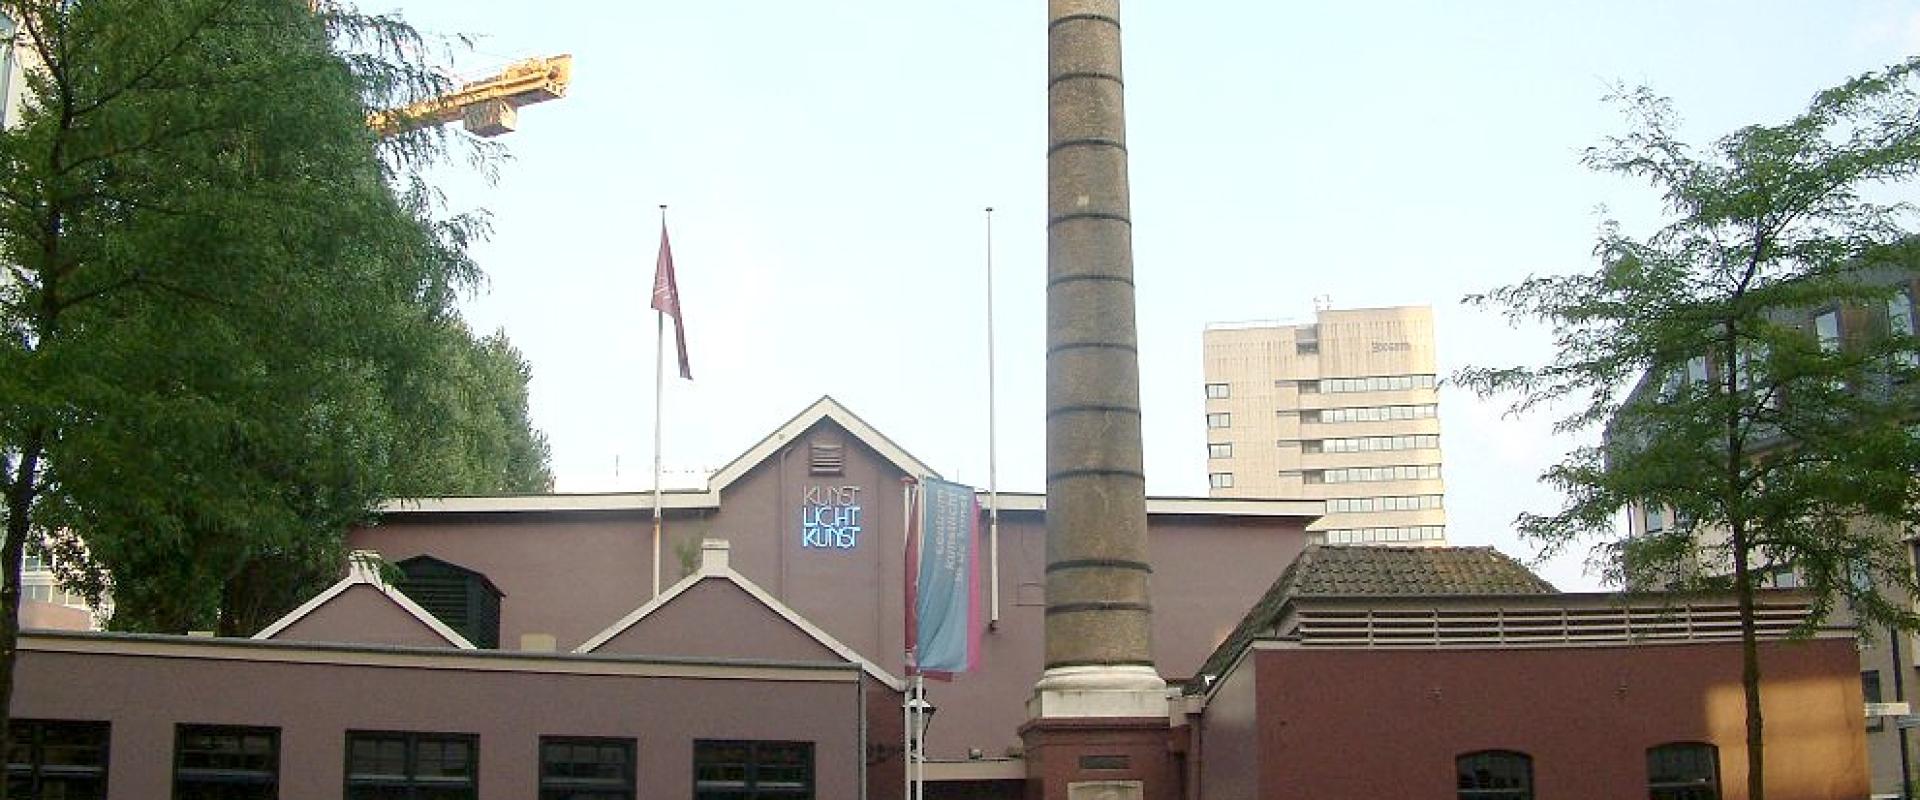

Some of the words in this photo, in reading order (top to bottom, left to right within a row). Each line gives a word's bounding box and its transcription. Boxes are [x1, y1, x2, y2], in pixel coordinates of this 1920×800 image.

[803, 485, 861, 506] KUNST
[803, 507, 861, 527] LICHT
[803, 527, 861, 547] KUNST
